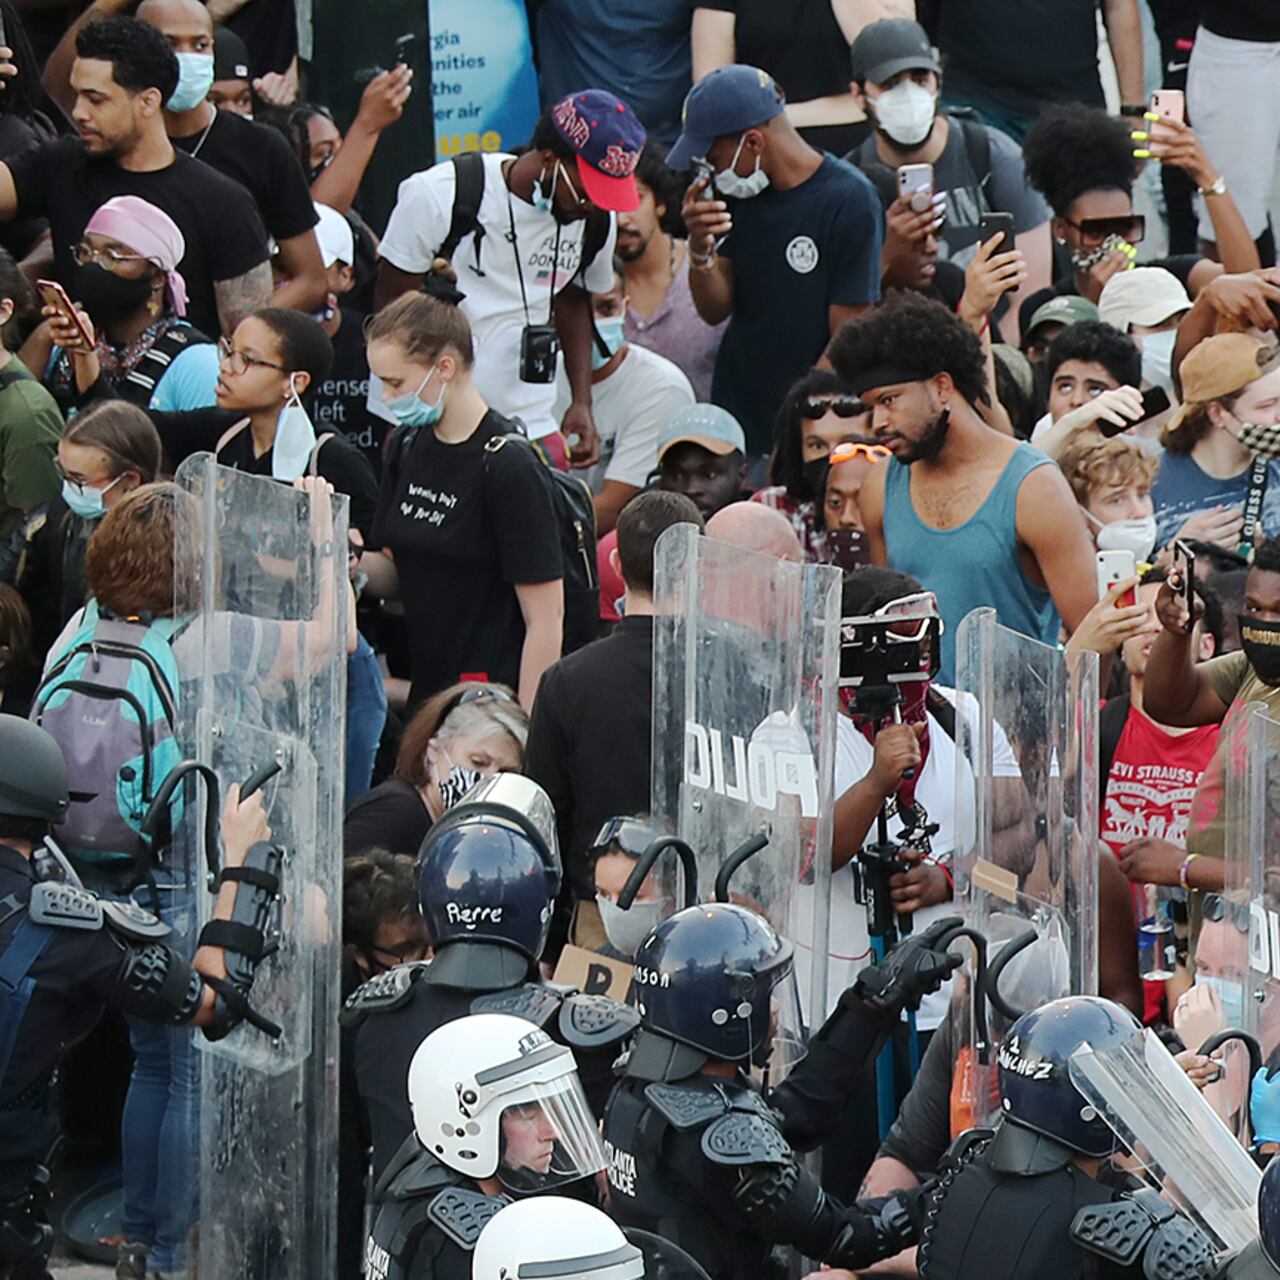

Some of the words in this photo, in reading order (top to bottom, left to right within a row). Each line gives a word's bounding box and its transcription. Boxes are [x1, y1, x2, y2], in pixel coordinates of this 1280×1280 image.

[434, 32, 461, 50] gia
[432, 55, 487, 70] nities
[458, 102, 484, 119] air
[318, 378, 369, 397] ense
[314, 400, 346, 422] left
[350, 427, 379, 447] ed.
[1243, 488, 1262, 537] GUESS
[1135, 764, 1194, 785] STRAUSS
